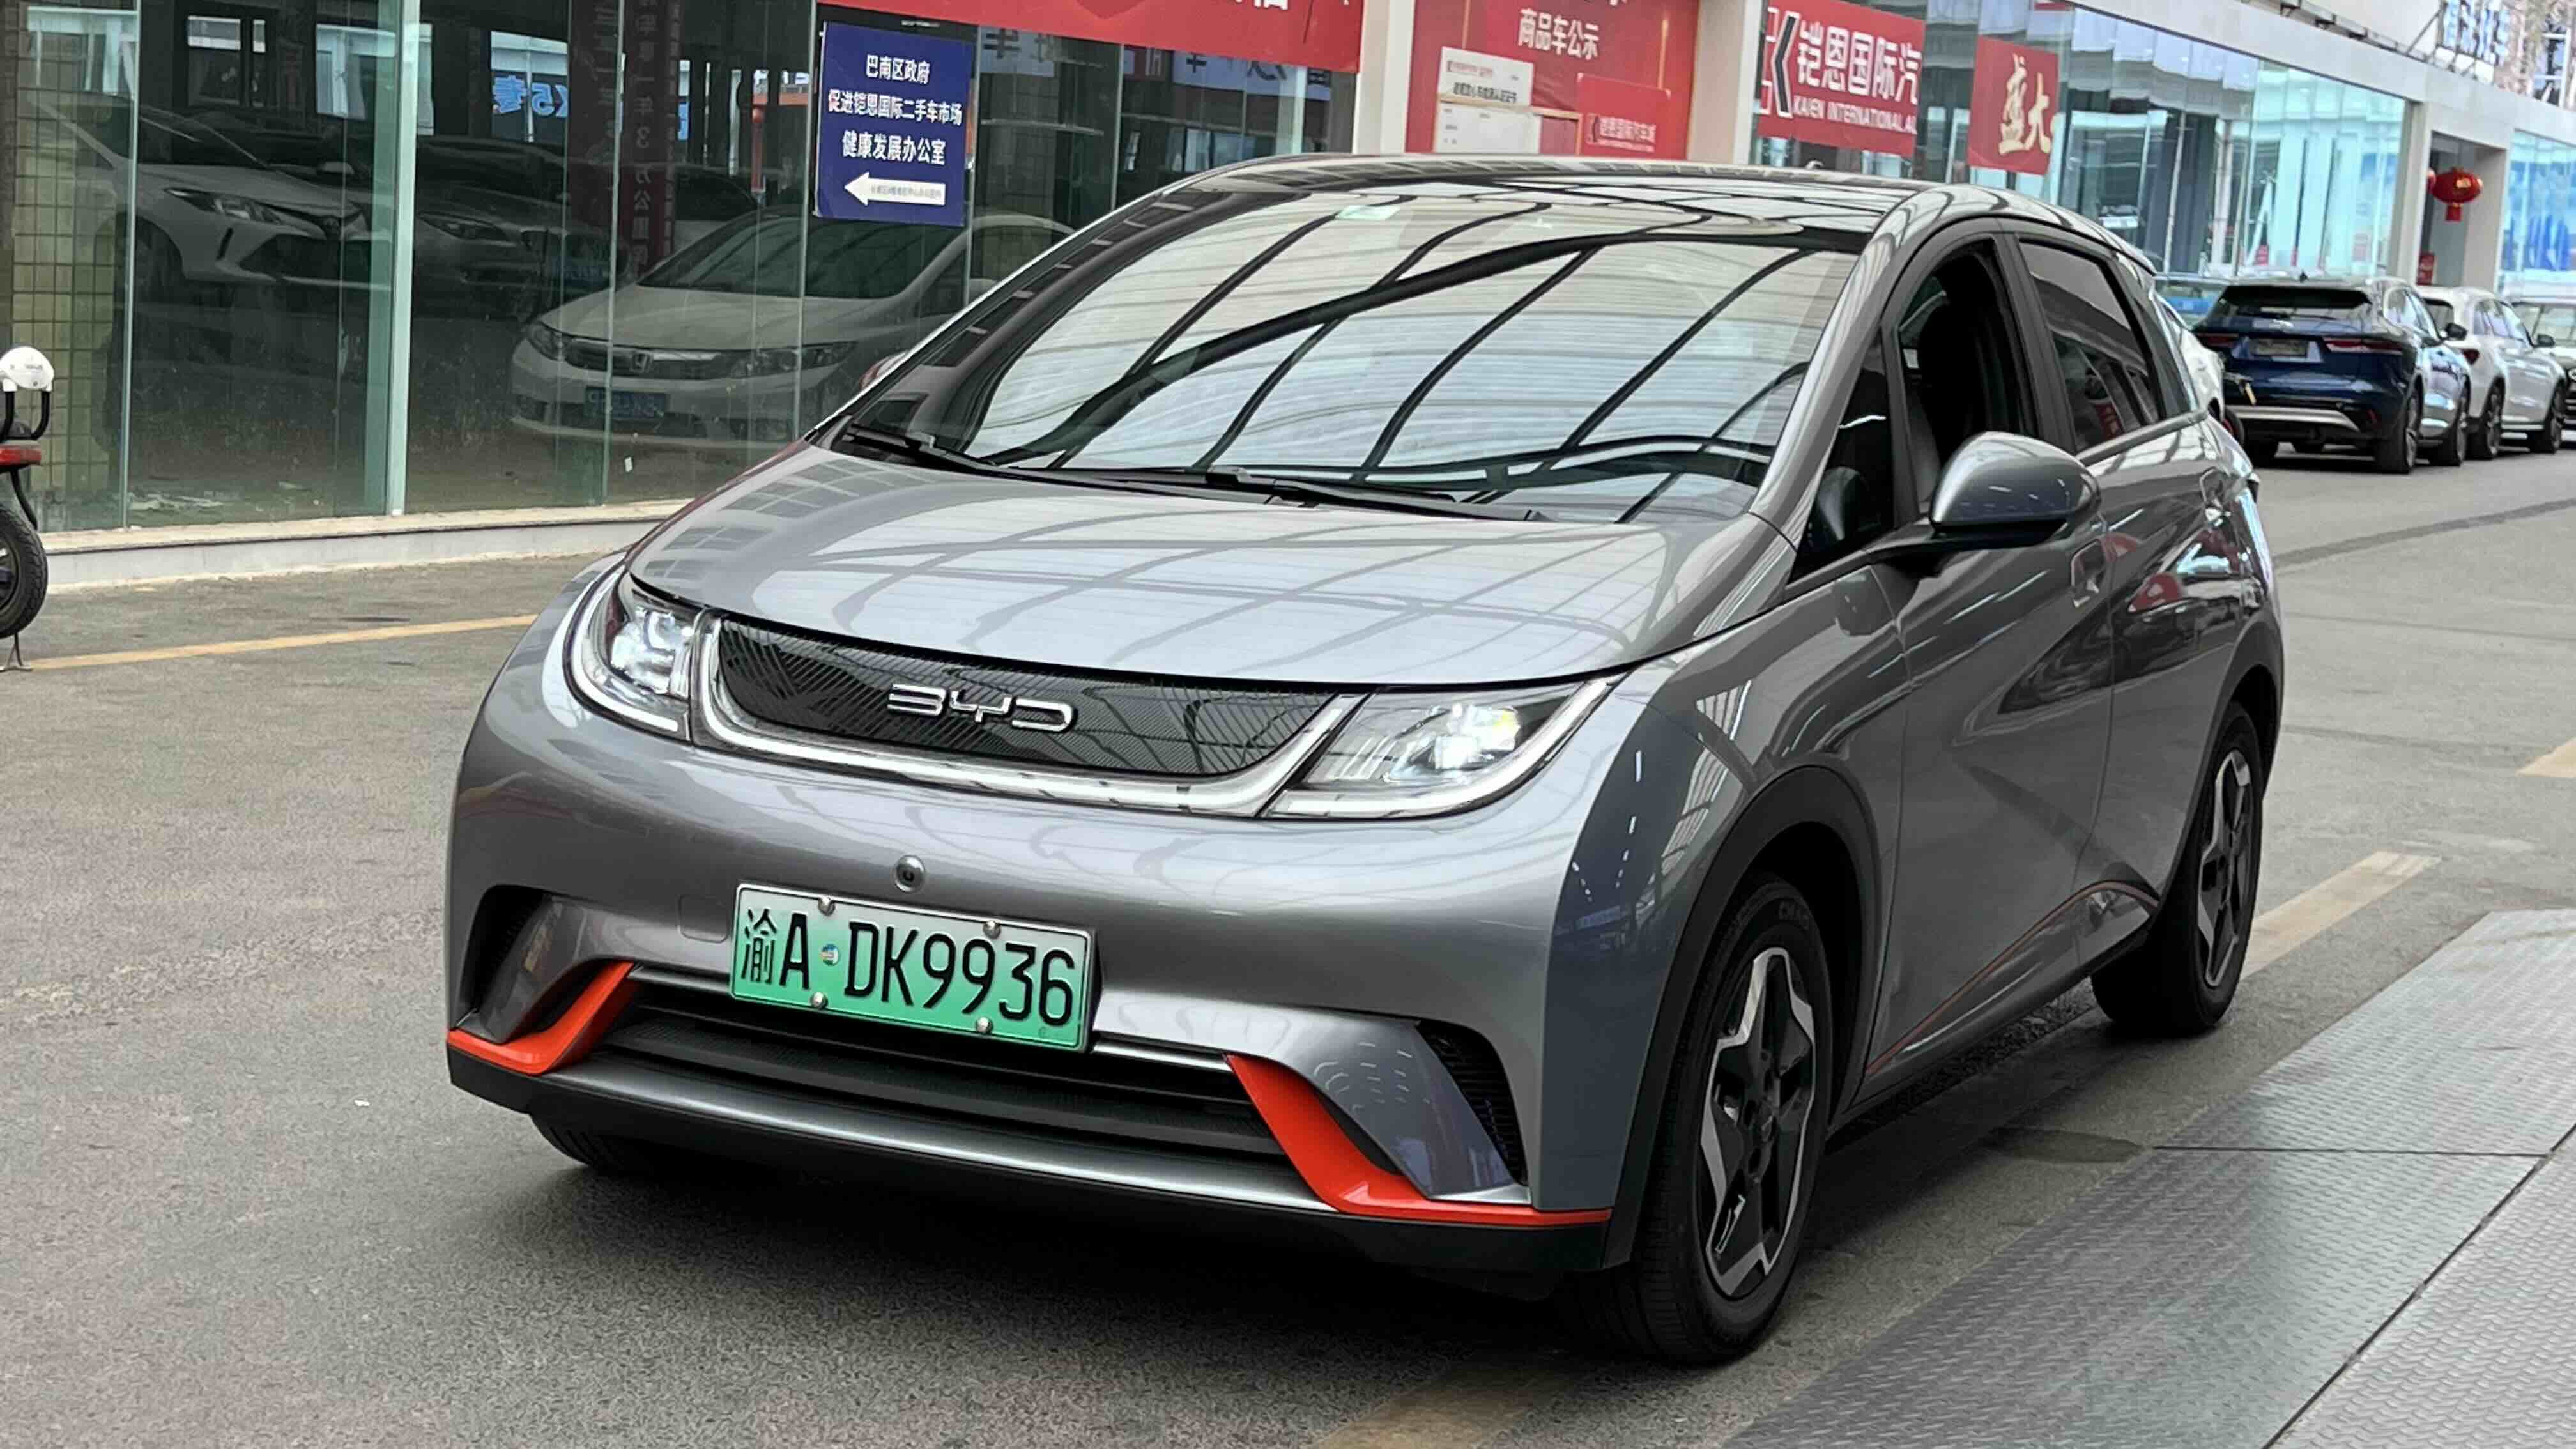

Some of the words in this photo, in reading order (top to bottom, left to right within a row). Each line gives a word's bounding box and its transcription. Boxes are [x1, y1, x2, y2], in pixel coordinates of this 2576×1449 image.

[1518, 8, 1600, 60] 商品车公示
[866, 54, 930, 84] 巴南区政府
[828, 89, 962, 125] 促进铠恩国际二手车市场
[1827, 102, 1903, 132] INTERNATIONAL
[1998, 53, 2057, 155] 盛大
[842, 130, 946, 165] 健康发展办公室
[887, 683, 1076, 732] BYD
[843, 921, 1076, 1027] DK9936
